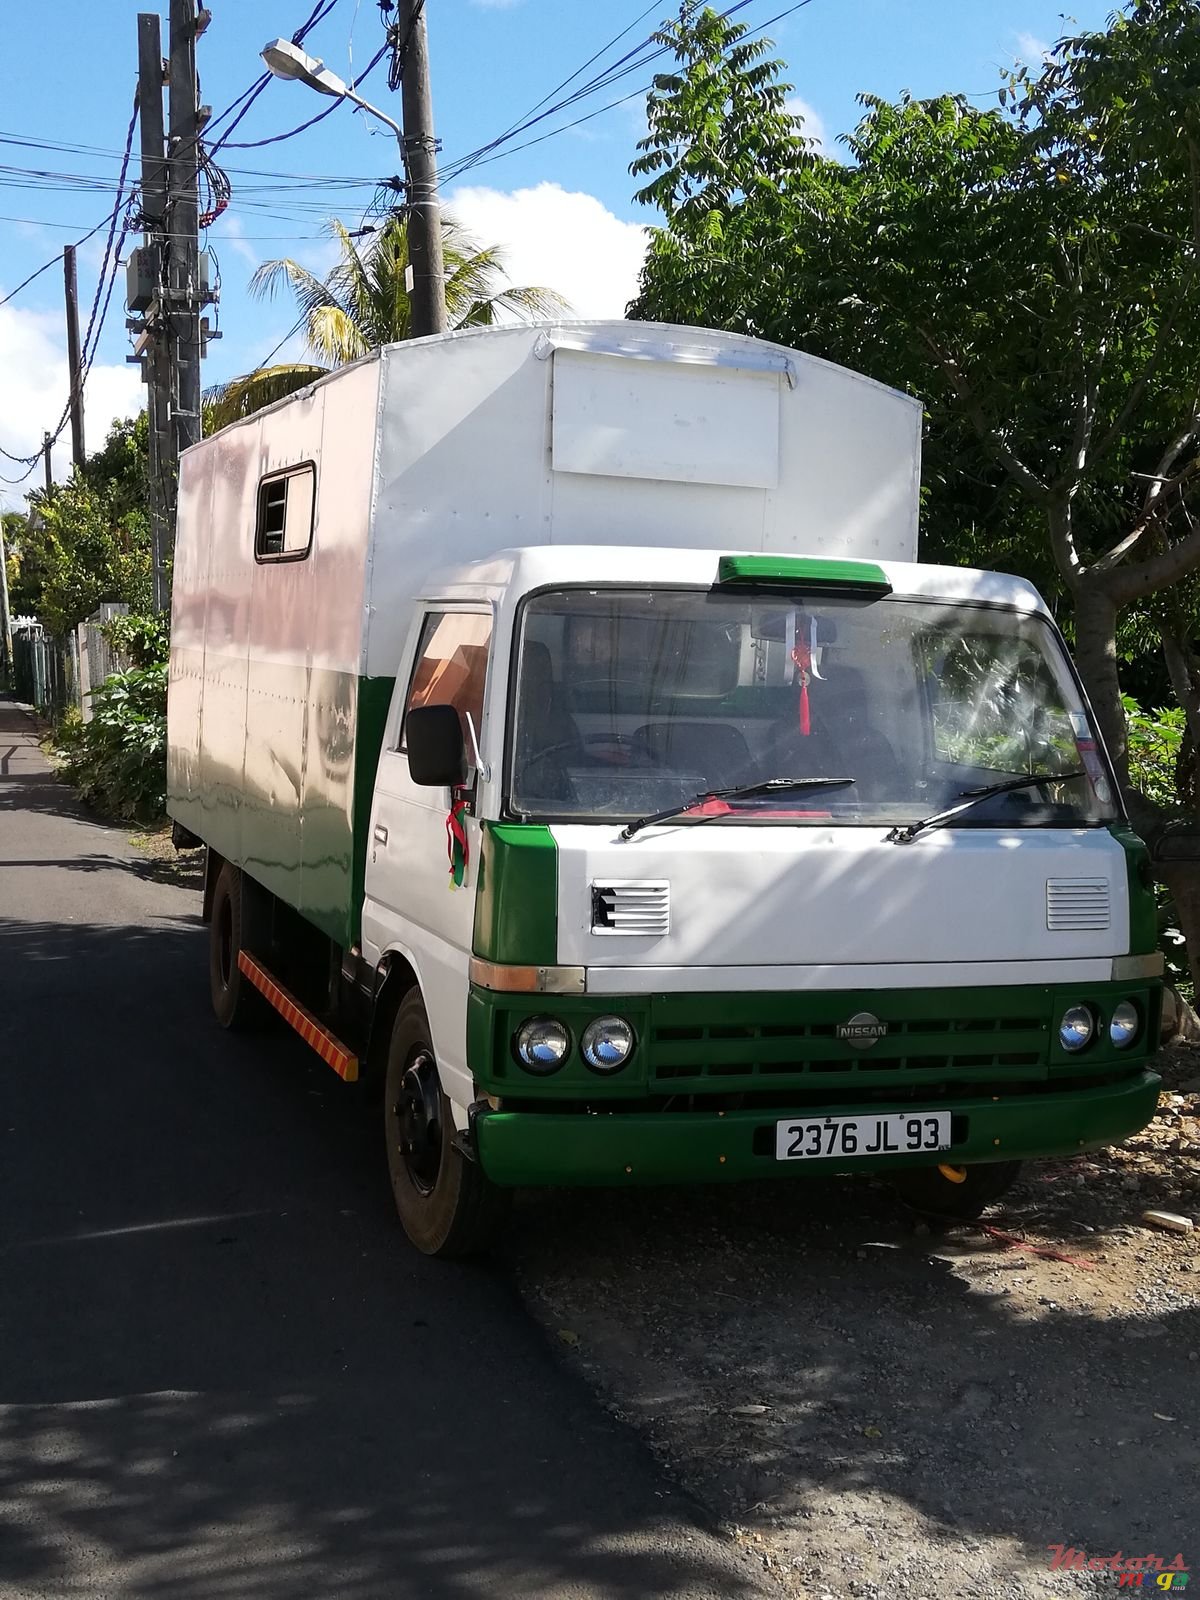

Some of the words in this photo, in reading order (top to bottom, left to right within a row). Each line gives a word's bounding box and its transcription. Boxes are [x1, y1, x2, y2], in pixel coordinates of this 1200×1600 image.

[840, 1025, 887, 1038] NISSAN
[786, 1122, 858, 1158] 2376
[865, 1120, 899, 1153] JL
[906, 1118, 940, 1150] 93
